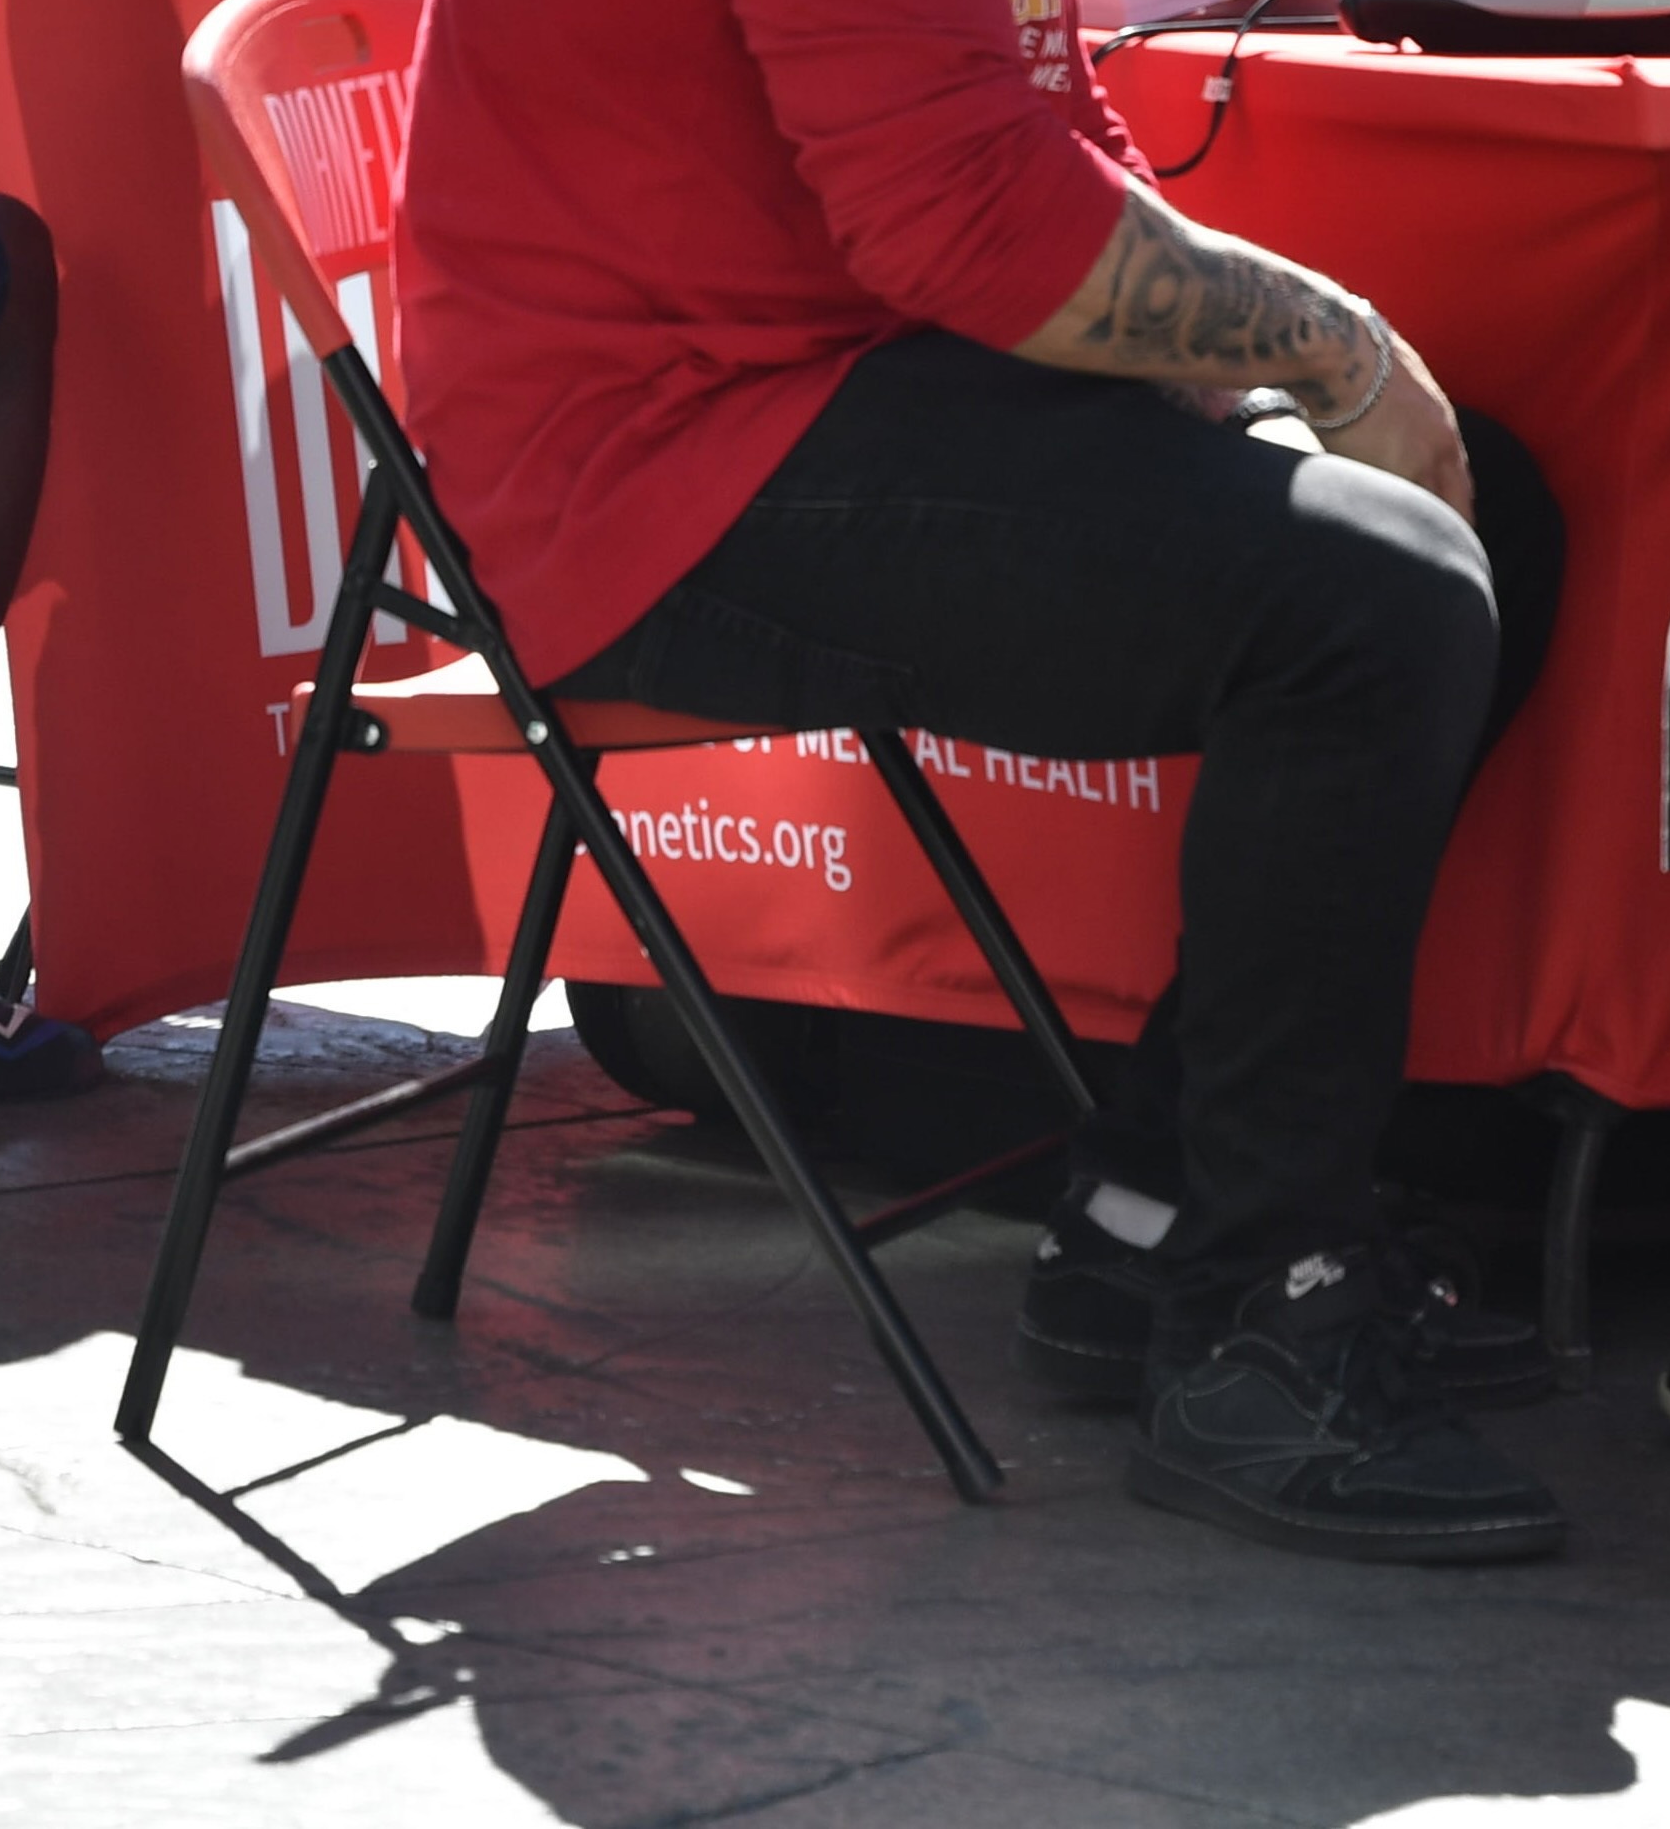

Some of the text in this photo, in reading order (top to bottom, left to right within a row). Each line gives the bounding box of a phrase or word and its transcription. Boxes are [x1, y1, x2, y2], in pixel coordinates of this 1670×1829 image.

[263, 64, 419, 259] DIANETI
[796, 727, 971, 778] MEAL
[577, 798, 852, 891] anetics.org
